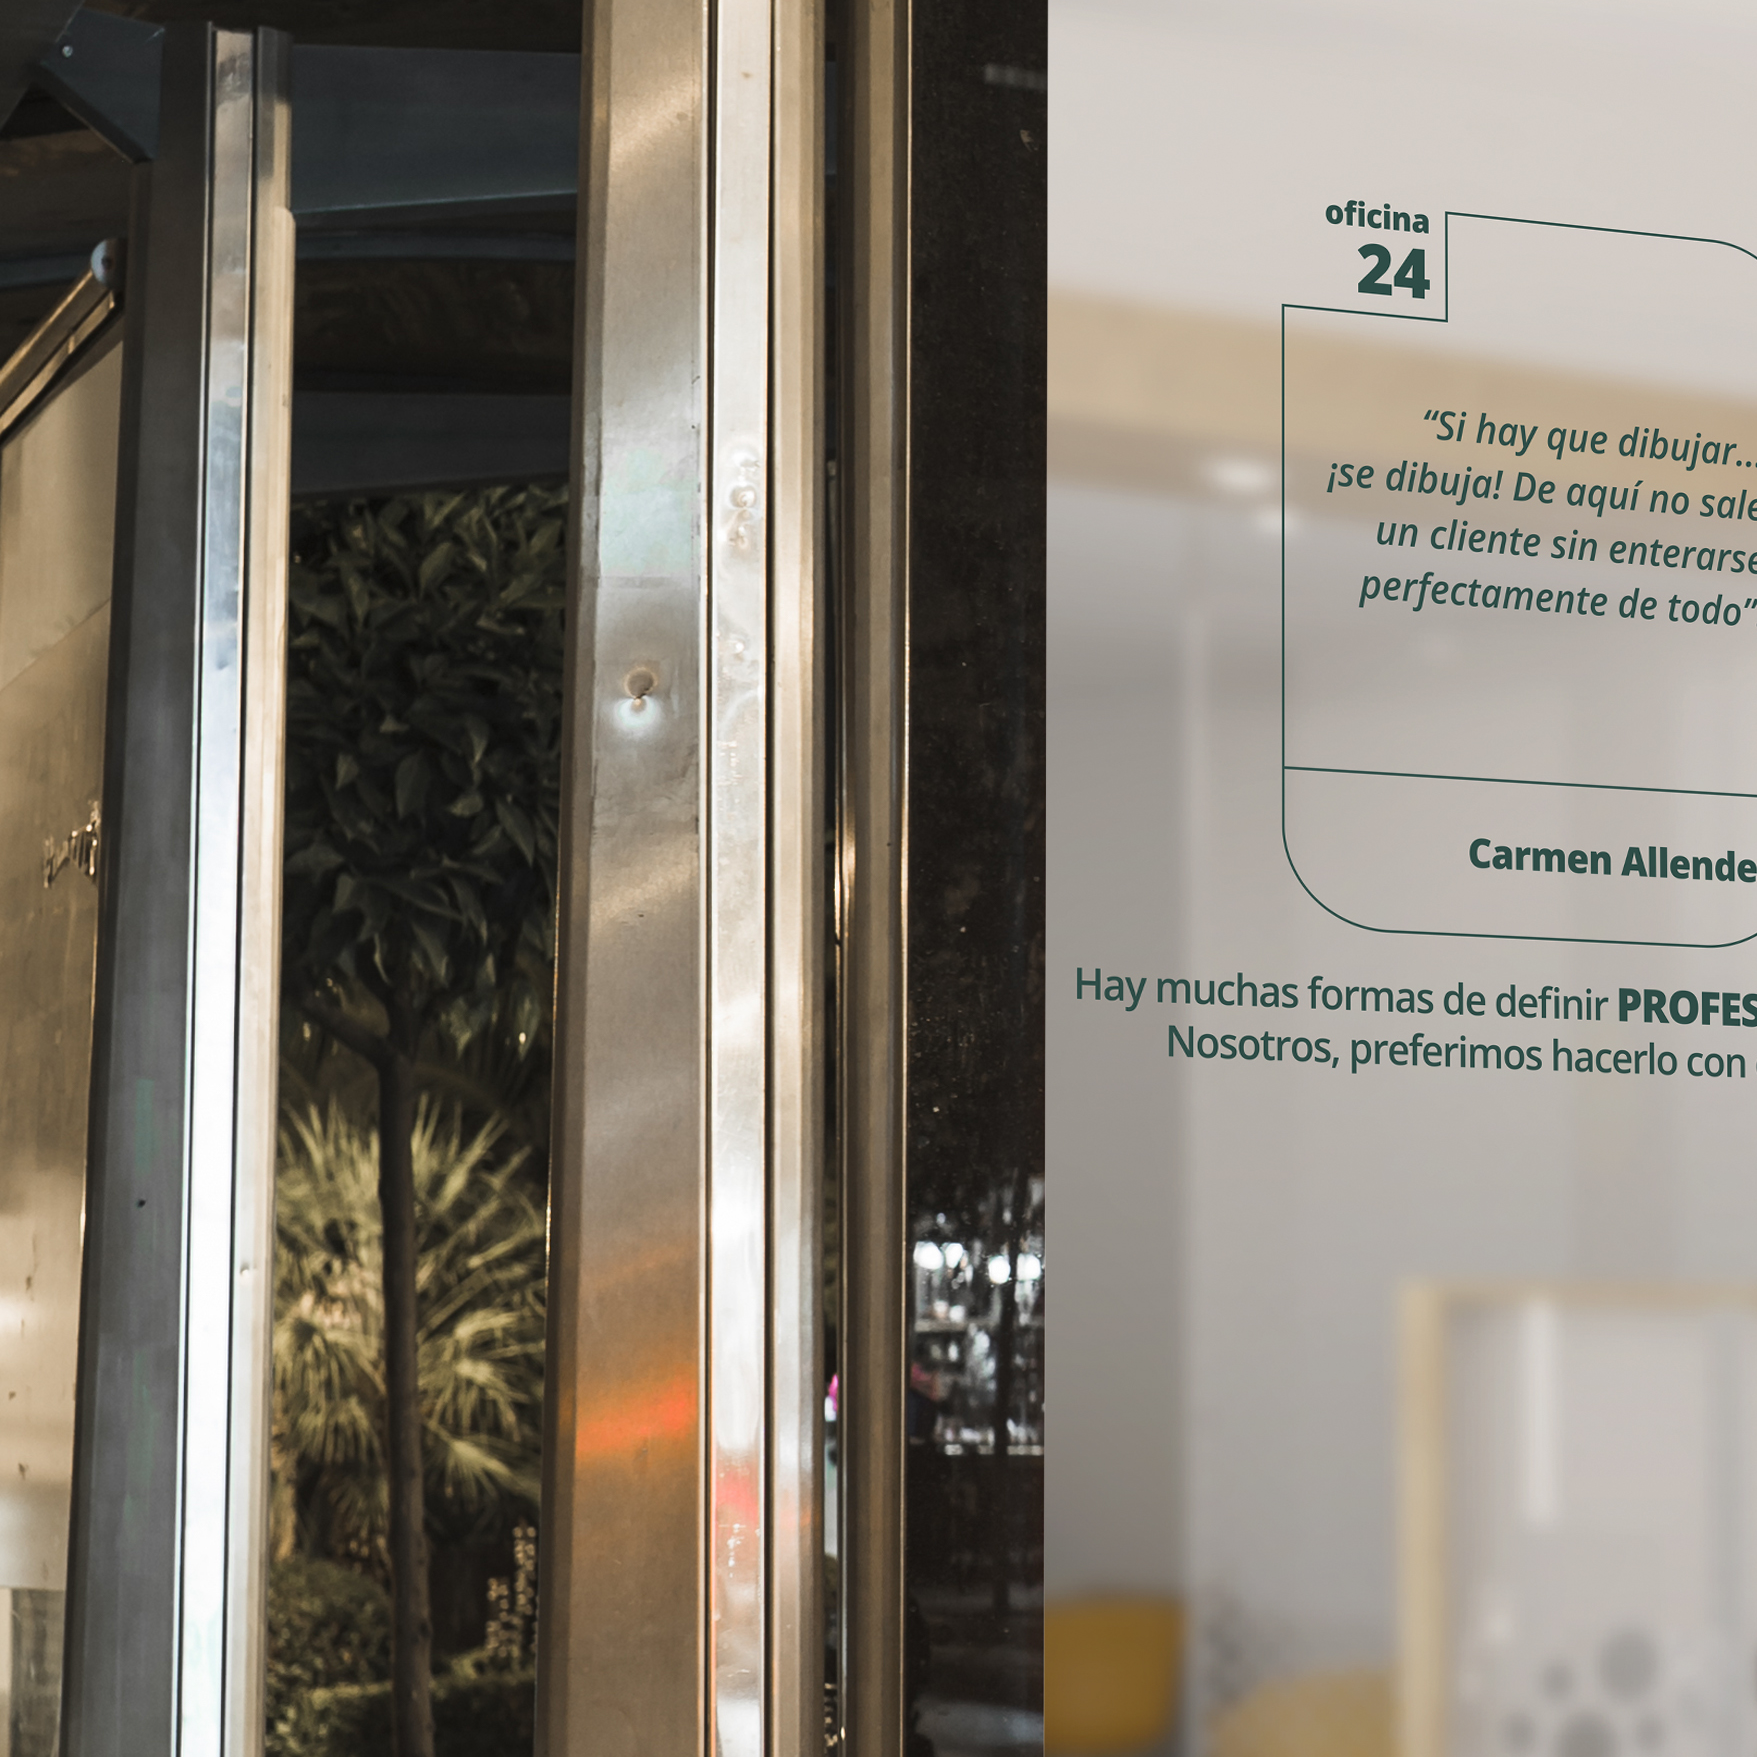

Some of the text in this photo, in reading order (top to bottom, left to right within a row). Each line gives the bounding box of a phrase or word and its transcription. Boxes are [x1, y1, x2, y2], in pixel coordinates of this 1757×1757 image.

[1325, 199, 1430, 234] oficina
[1357, 243, 1431, 300] 24
[1423, 409, 1467, 442] “Si
[1476, 412, 1539, 457] hay
[1547, 427, 1608, 461] que
[1326, 462, 1375, 493] ¡se
[1385, 460, 1504, 506] dibuja!
[1513, 471, 1556, 504] De
[1566, 479, 1644, 518] aquí
[1649, 490, 1690, 515] no
[1376, 521, 1418, 548] un
[1430, 518, 1541, 557] cliente
[1550, 529, 1598, 562] sin
[1358, 571, 1608, 617] perfectamente
[1618, 587, 1658, 620] de
[1469, 837, 1612, 876] Carmen
[1076, 967, 1148, 1012] Hay
[1157, 972, 1299, 1009] muchas
[1307, 975, 1434, 1014] formas
[1443, 981, 1486, 1017] de
[1495, 984, 1609, 1021] definir
[1168, 1024, 1340, 1069] Nosotros,
[1351, 1032, 1543, 1075] preferimos
[1552, 1038, 1678, 1076] hacerlo
[1687, 1052, 1746, 1078] con
